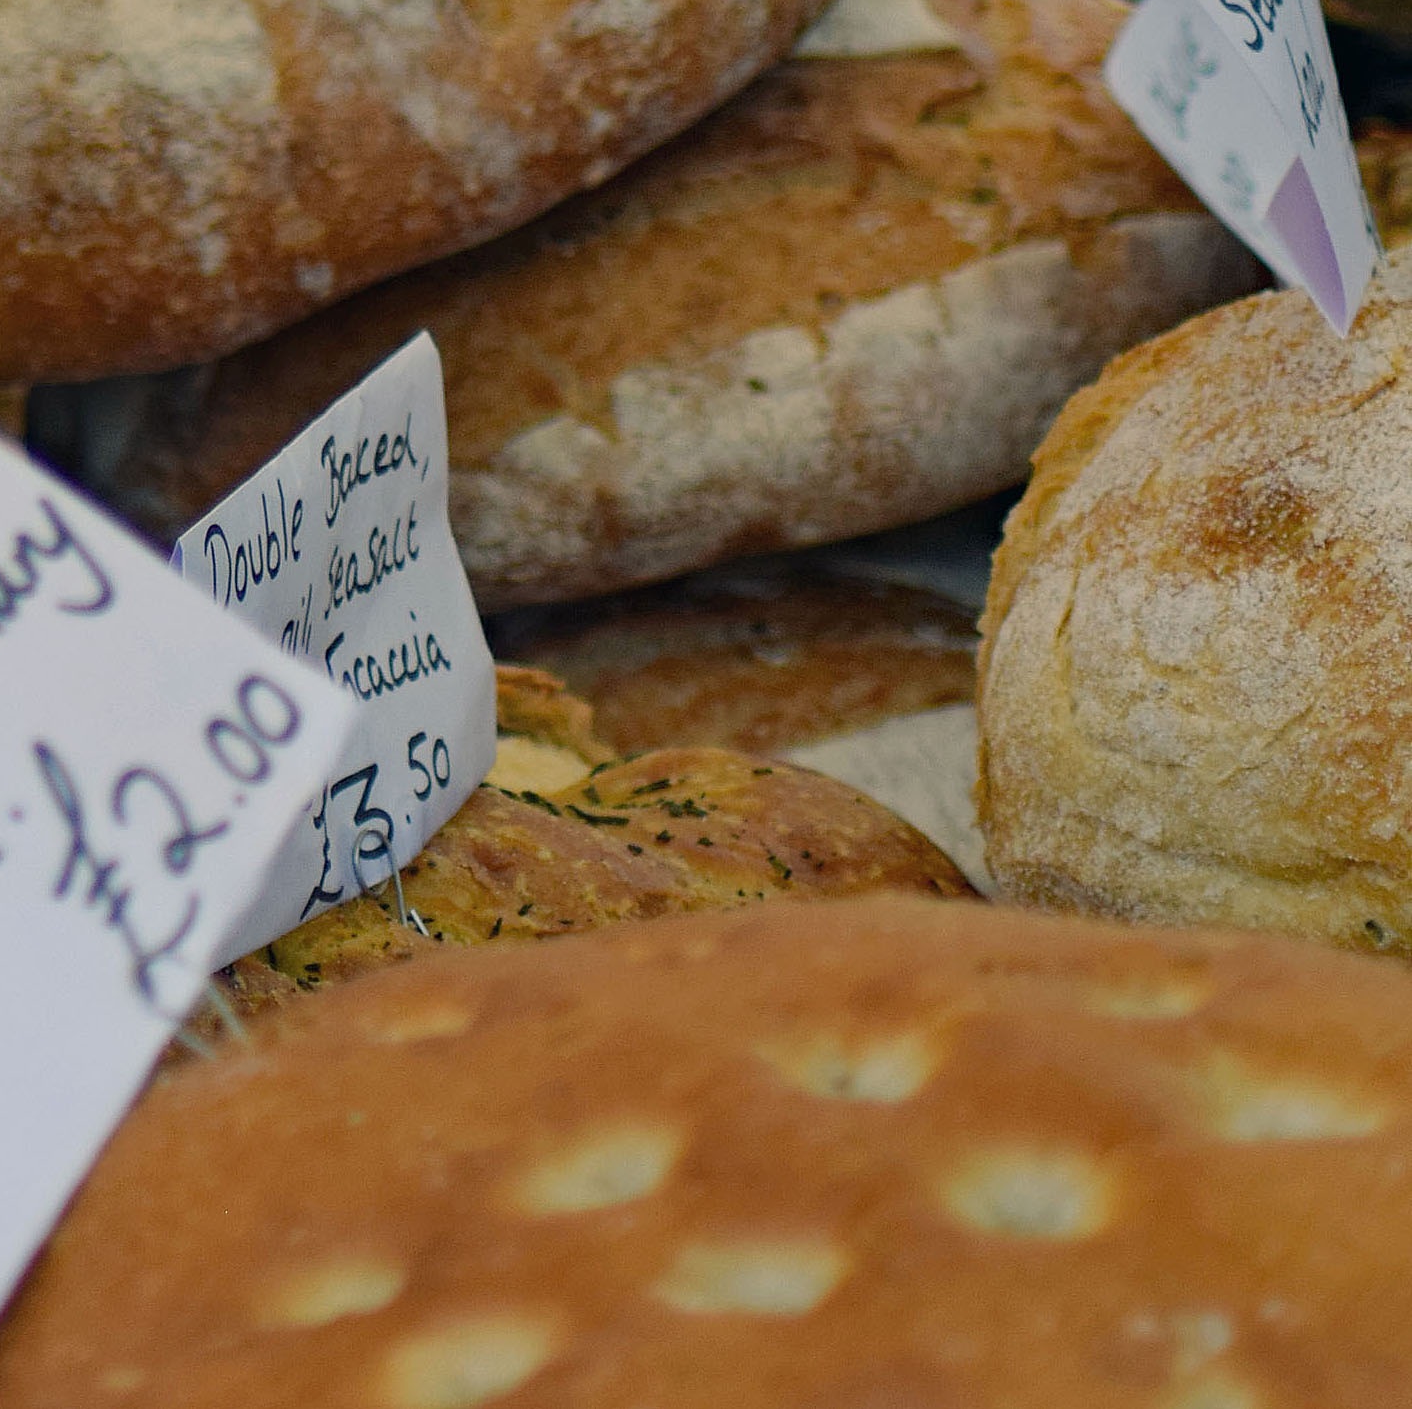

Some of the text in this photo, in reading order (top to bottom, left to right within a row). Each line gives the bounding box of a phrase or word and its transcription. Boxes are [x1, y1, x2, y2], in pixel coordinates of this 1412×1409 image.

[204, 479, 304, 609] Double
[32, 672, 303, 1009] £2.00
[299, 731, 451, 922] £3.50
